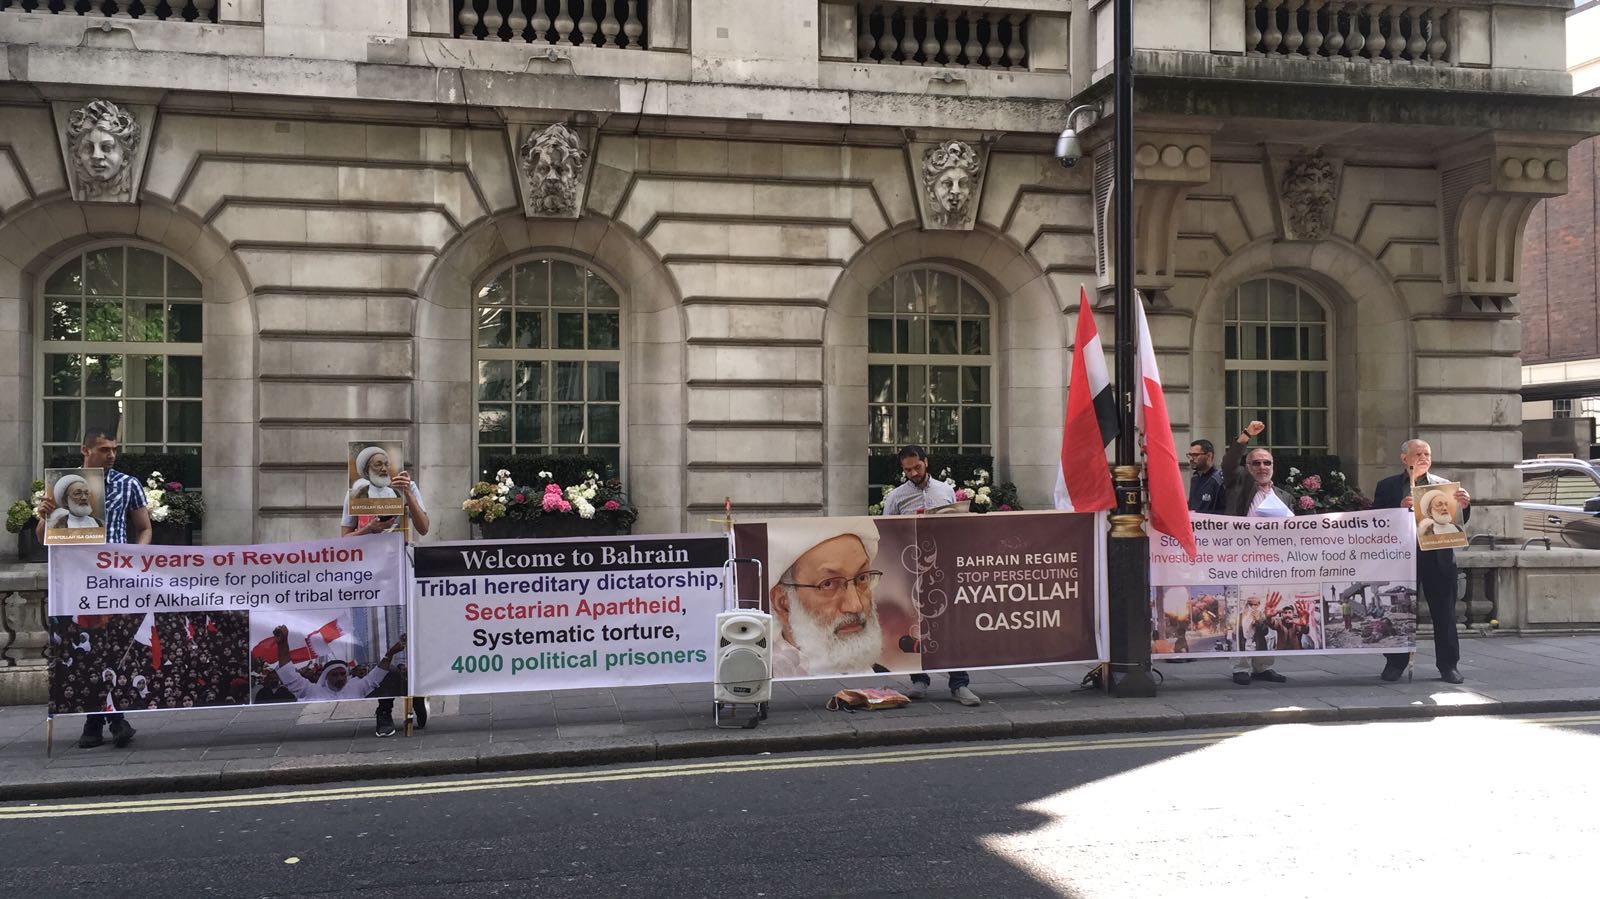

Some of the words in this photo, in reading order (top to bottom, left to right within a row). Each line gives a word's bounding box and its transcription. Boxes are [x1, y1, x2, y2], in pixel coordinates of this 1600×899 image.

[1232, 520, 1250, 530] we
[1255, 520, 1279, 530] can
[1283, 519, 1317, 530] force
[1321, 517, 1368, 529] Saudis
[1372, 517, 1390, 528] to:
[1160, 536, 1182, 549] Sto
[1195, 535, 1209, 547] he
[1211, 537, 1233, 547] war
[1236, 537, 1251, 547] on
[1253, 535, 1297, 548] Yemen,
[1300, 535, 1344, 546] remove
[96, 551, 134, 569] Six
[141, 553, 205, 573] years
[212, 551, 235, 566] of
[242, 546, 364, 566] Revolution
[460, 548, 566, 570] Welcome
[571, 549, 594, 566] to
[600, 544, 689, 565] Bahrain
[956, 554, 1020, 567] BAHRAIN
[1025, 552, 1078, 565] REGIME
[1217, 553, 1238, 563] war
[1241, 551, 1284, 564] crimes,
[1286, 550, 1318, 562] Allow
[1321, 549, 1346, 562] food
[1349, 549, 1357, 560] &
[1360, 548, 1411, 560] medicine
[86, 574, 164, 590] Bahrainis
[169, 572, 220, 589] aspire
[225, 572, 246, 586] for
[251, 569, 310, 587] political
[315, 569, 373, 584] change
[416, 578, 477, 597] Tribal
[484, 575, 590, 595] hereditary
[597, 570, 724, 591] dictatorship,
[957, 571, 990, 584] STOP
[993, 567, 1079, 582] PERSECUTING
[1208, 567, 1238, 579] Save
[1241, 567, 1287, 579] children
[1291, 566, 1316, 578] from
[1319, 566, 1356, 577] famine
[78, 595, 90, 610] &
[97, 594, 129, 609] End
[135, 594, 151, 608] of
[154, 592, 224, 607] Alkhalifa
[229, 591, 270, 608] reign
[275, 589, 294, 604] of
[294, 588, 333, 603] tribal
[338, 588, 381, 601] terror
[953, 581, 1079, 605] AYATOLLAH
[465, 600, 569, 621] Sectarian
[575, 595, 687, 621] Apartheid,
[975, 609, 1061, 631] QASSIM
[472, 625, 595, 651] Systematic
[601, 623, 680, 642] torture,
[451, 654, 503, 674] 4000
[511, 650, 598, 676] political
[605, 648, 708, 671] prisoners
